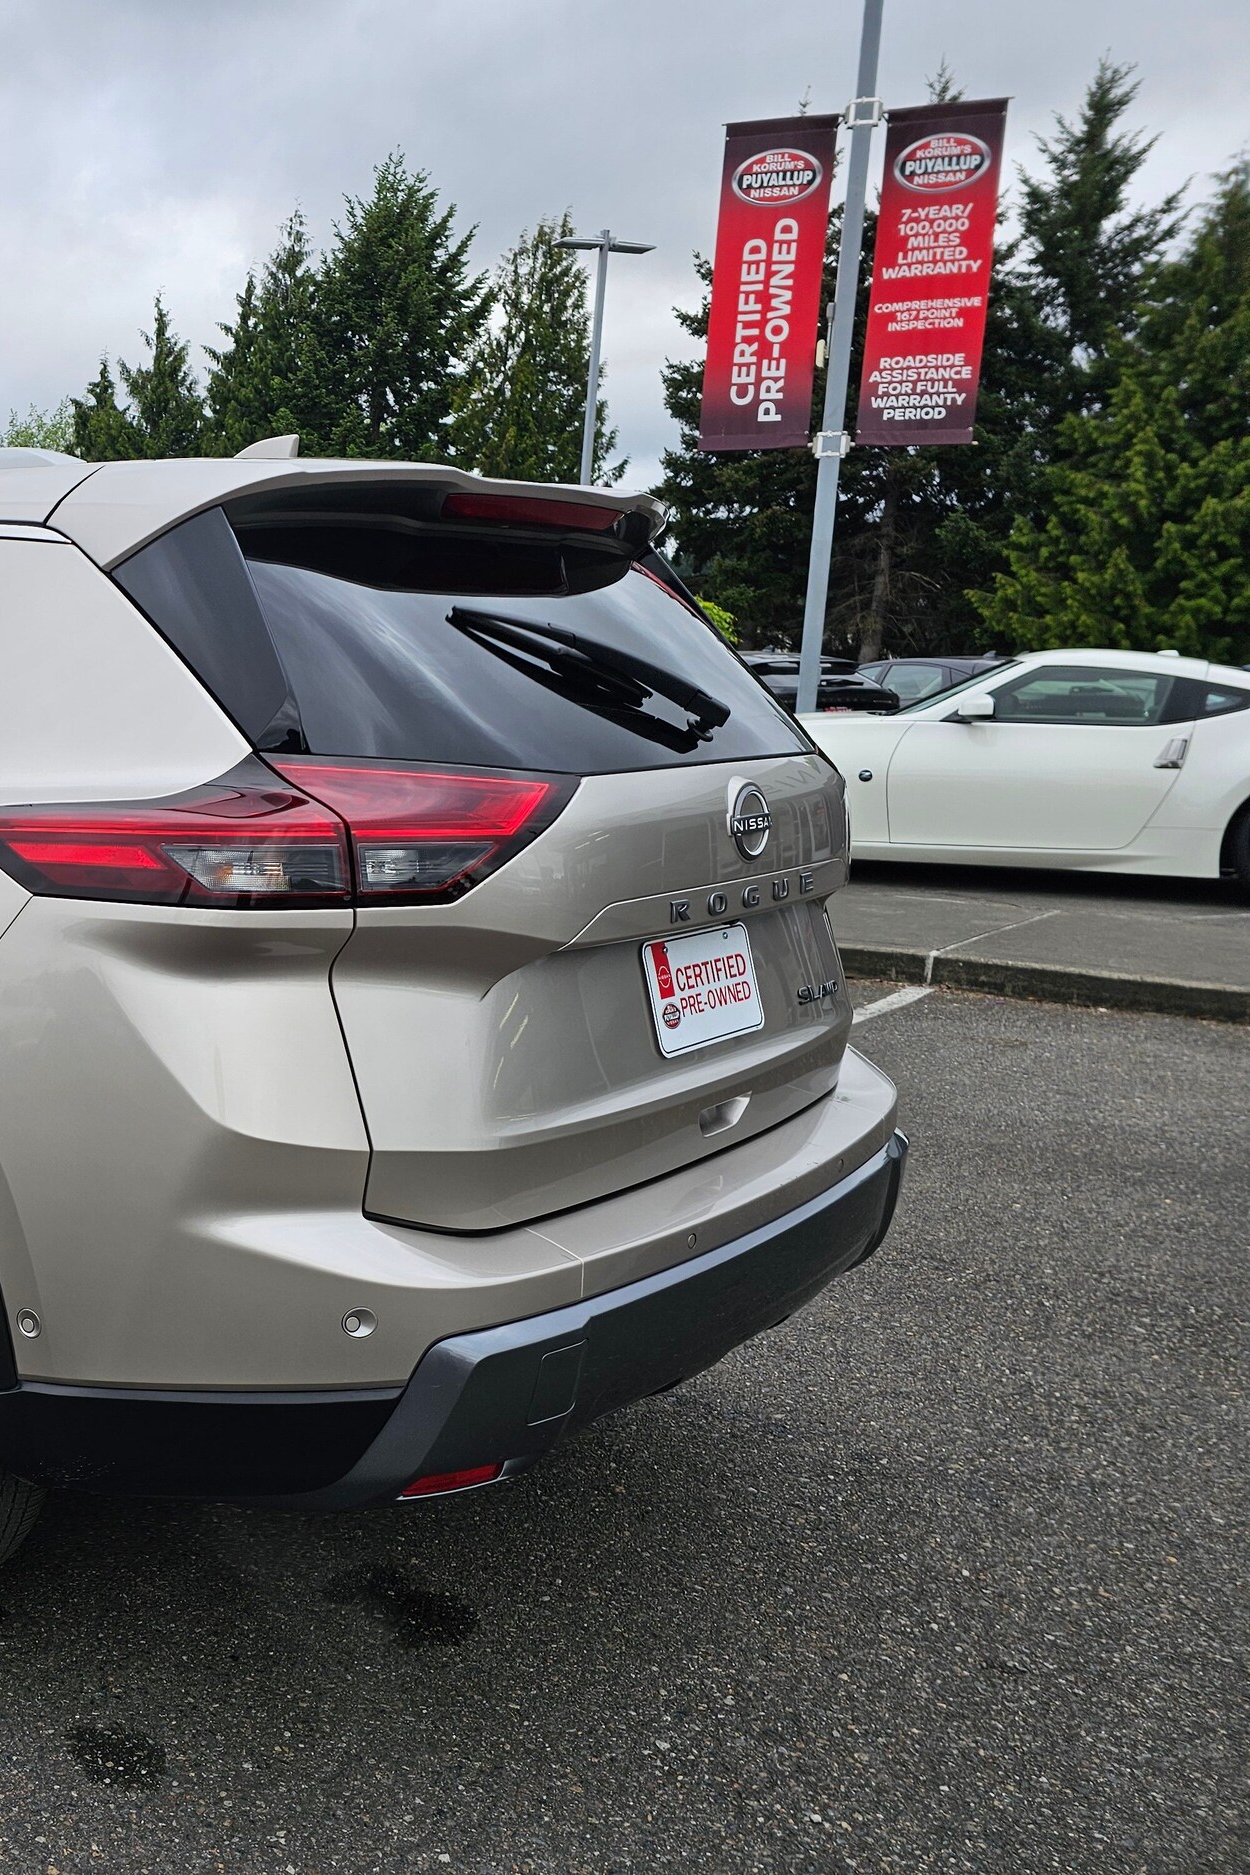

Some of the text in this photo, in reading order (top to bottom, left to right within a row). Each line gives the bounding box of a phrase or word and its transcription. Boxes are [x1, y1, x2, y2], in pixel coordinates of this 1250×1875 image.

[915, 145, 972, 158] KORUM'S
[931, 138, 957, 149] BILL
[752, 160, 805, 172] KORUM'S
[765, 153, 791, 163] BILL
[904, 154, 981, 176] PUYALLUP
[742, 170, 813, 189] PUYALLUP
[913, 171, 966, 185] NISSAN
[750, 187, 799, 198] NISSAN
[901, 202, 974, 222] 7-YEAR/
[897, 218, 969, 236] 100,000
[907, 232, 961, 249] MILES
[897, 246, 968, 264] LIMITED
[882, 259, 982, 279] WARRANTY
[874, 296, 982, 313] COMPREHENSIVE
[730, 238, 767, 406] CERTIFIED
[757, 217, 799, 422] PRE-OWNED
[895, 308, 959, 321] 167 POINT
[887, 318, 964, 332] INSPECTION
[879, 352, 966, 369] ROADSIDE
[868, 366, 972, 383] ASSISTANCE
[877, 380, 957, 395] FOR FULL
[871, 392, 966, 409] WARRANTY
[882, 407, 947, 421] PERIOD
[670, 871, 814, 924] ROGUE
[675, 953, 747, 992] CERTIFIED
[679, 980, 752, 1018] PRE-OWNED
